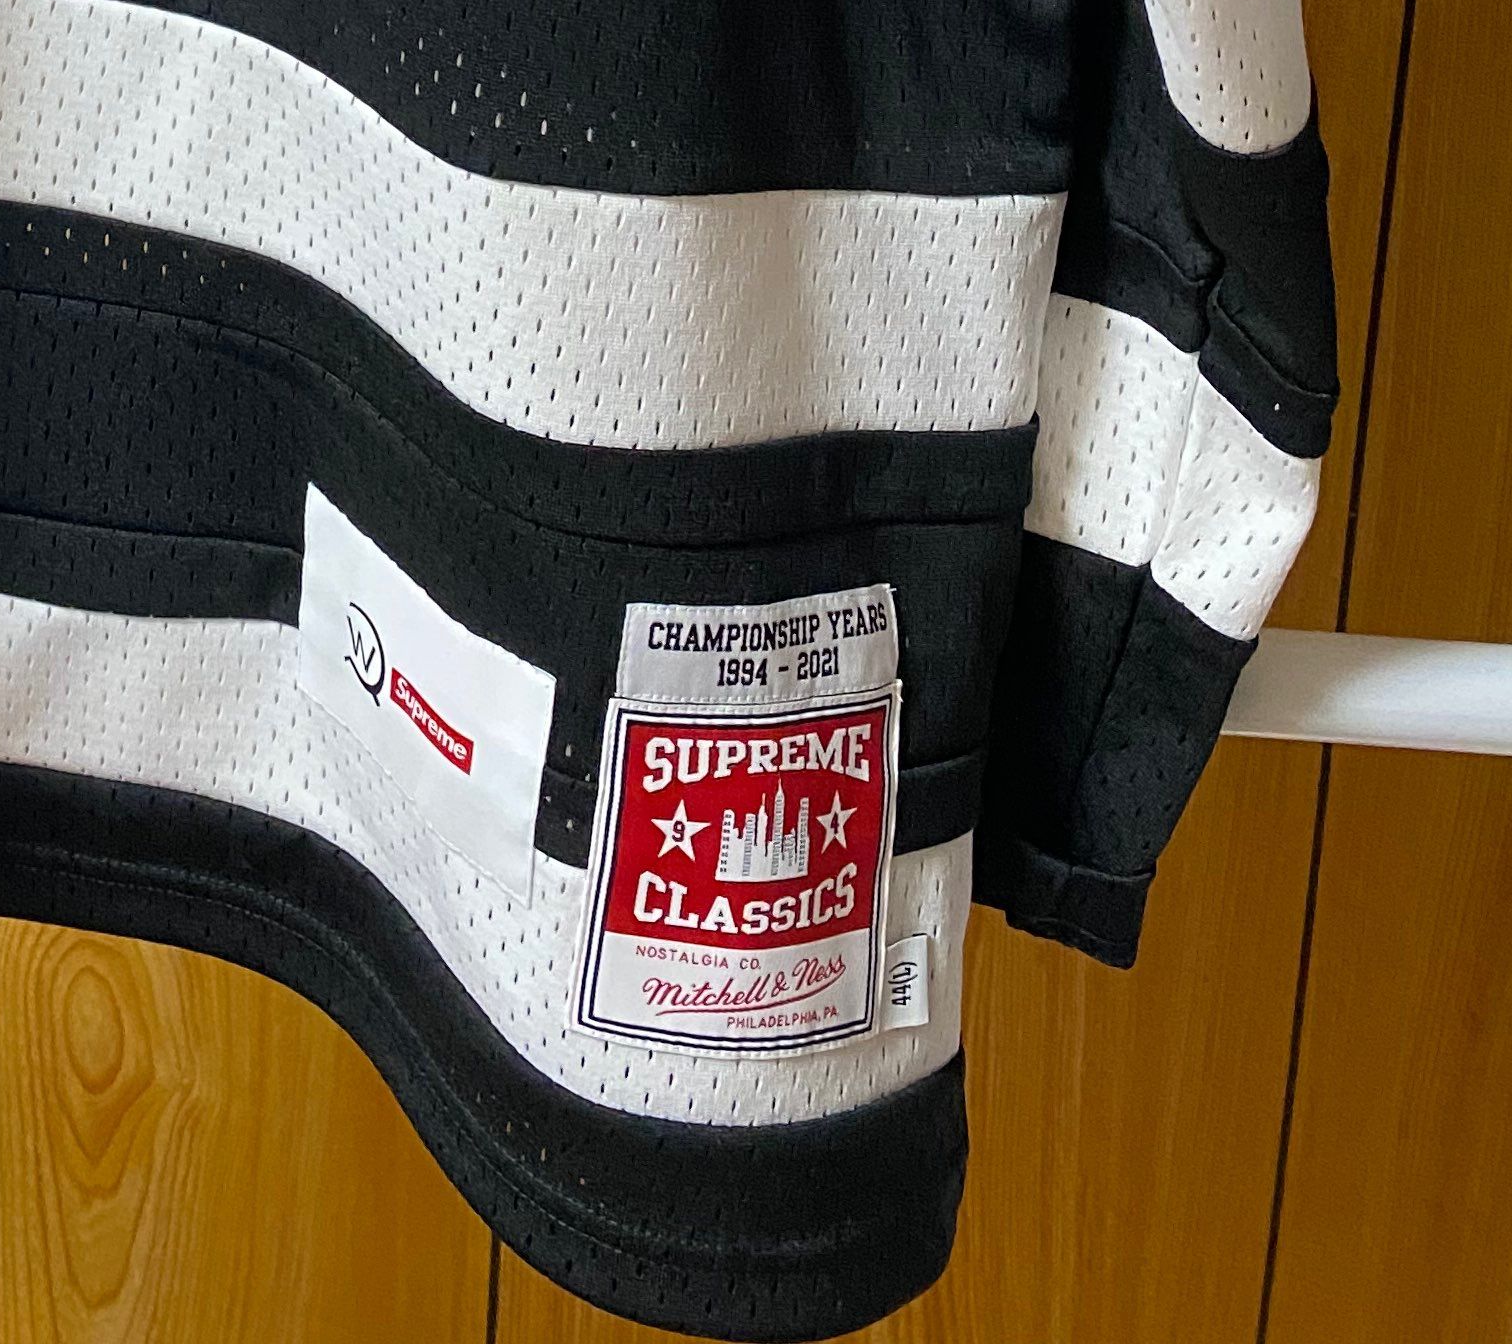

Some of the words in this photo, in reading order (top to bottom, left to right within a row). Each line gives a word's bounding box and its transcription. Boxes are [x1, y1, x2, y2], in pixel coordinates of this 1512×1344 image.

[648, 614, 820, 652] CHAMPIONSHIP
[826, 602, 887, 640] YEARS
[717, 658, 768, 686] 1994
[797, 647, 839, 680] 2021
[394, 677, 468, 760] Supreme
[642, 723, 872, 793] SUPREME
[672, 820, 686, 843] 9
[634, 862, 858, 935] CLASSICS
[636, 945, 729, 969] NOSTALGIA
[642, 971, 770, 1007] Mitchell
[771, 971, 791, 998] &
[792, 955, 846, 991] Ness
[888, 961, 918, 1006] 44(L)
